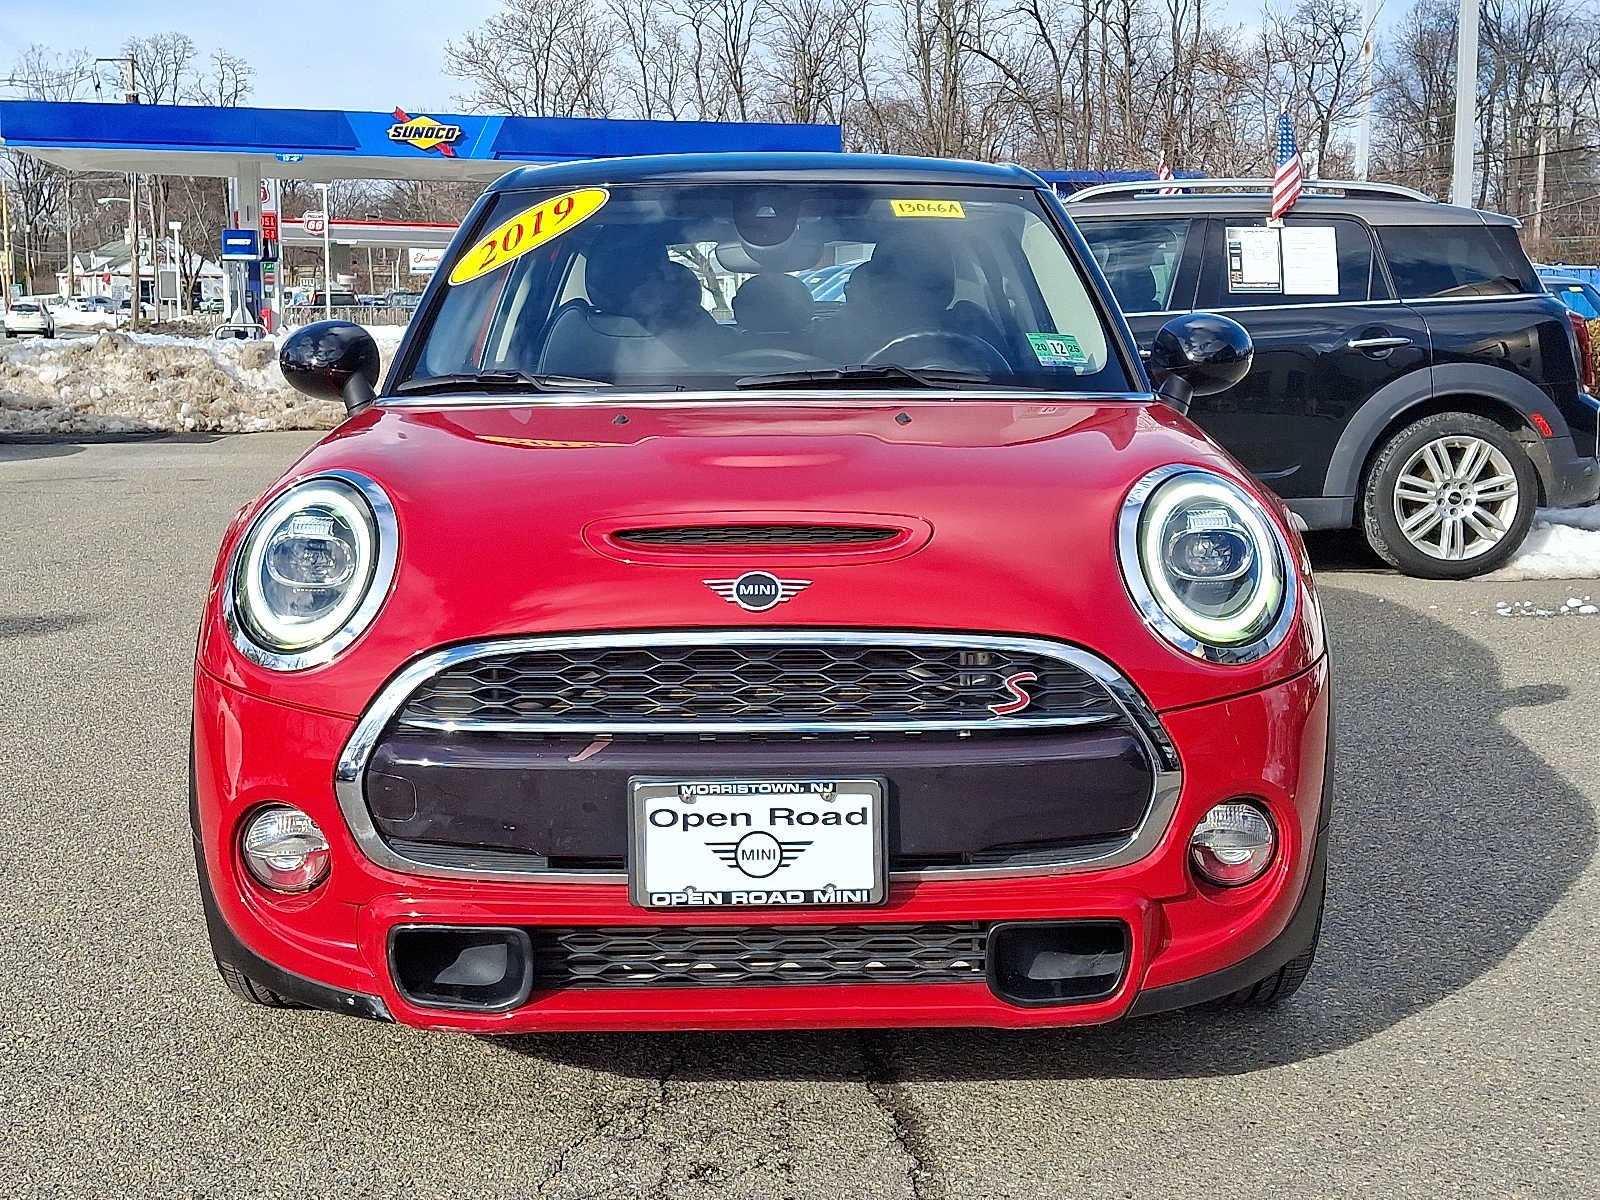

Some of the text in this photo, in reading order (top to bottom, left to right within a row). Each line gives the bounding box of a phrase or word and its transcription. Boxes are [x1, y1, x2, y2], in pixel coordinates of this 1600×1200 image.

[391, 126, 457, 140] SUNOCO
[898, 203, 960, 214] 13066A
[307, 220, 324, 231] 66
[478, 196, 575, 271] 2019
[1034, 342, 1081, 354] 20 12 25
[739, 584, 776, 596] MINI
[987, 671, 1038, 716] S
[680, 783, 834, 796] MORRISTOWN, NJ
[649, 807, 868, 832] Open Road
[741, 848, 776, 861] MINI
[651, 889, 869, 906] OPEN ROAD MINI
